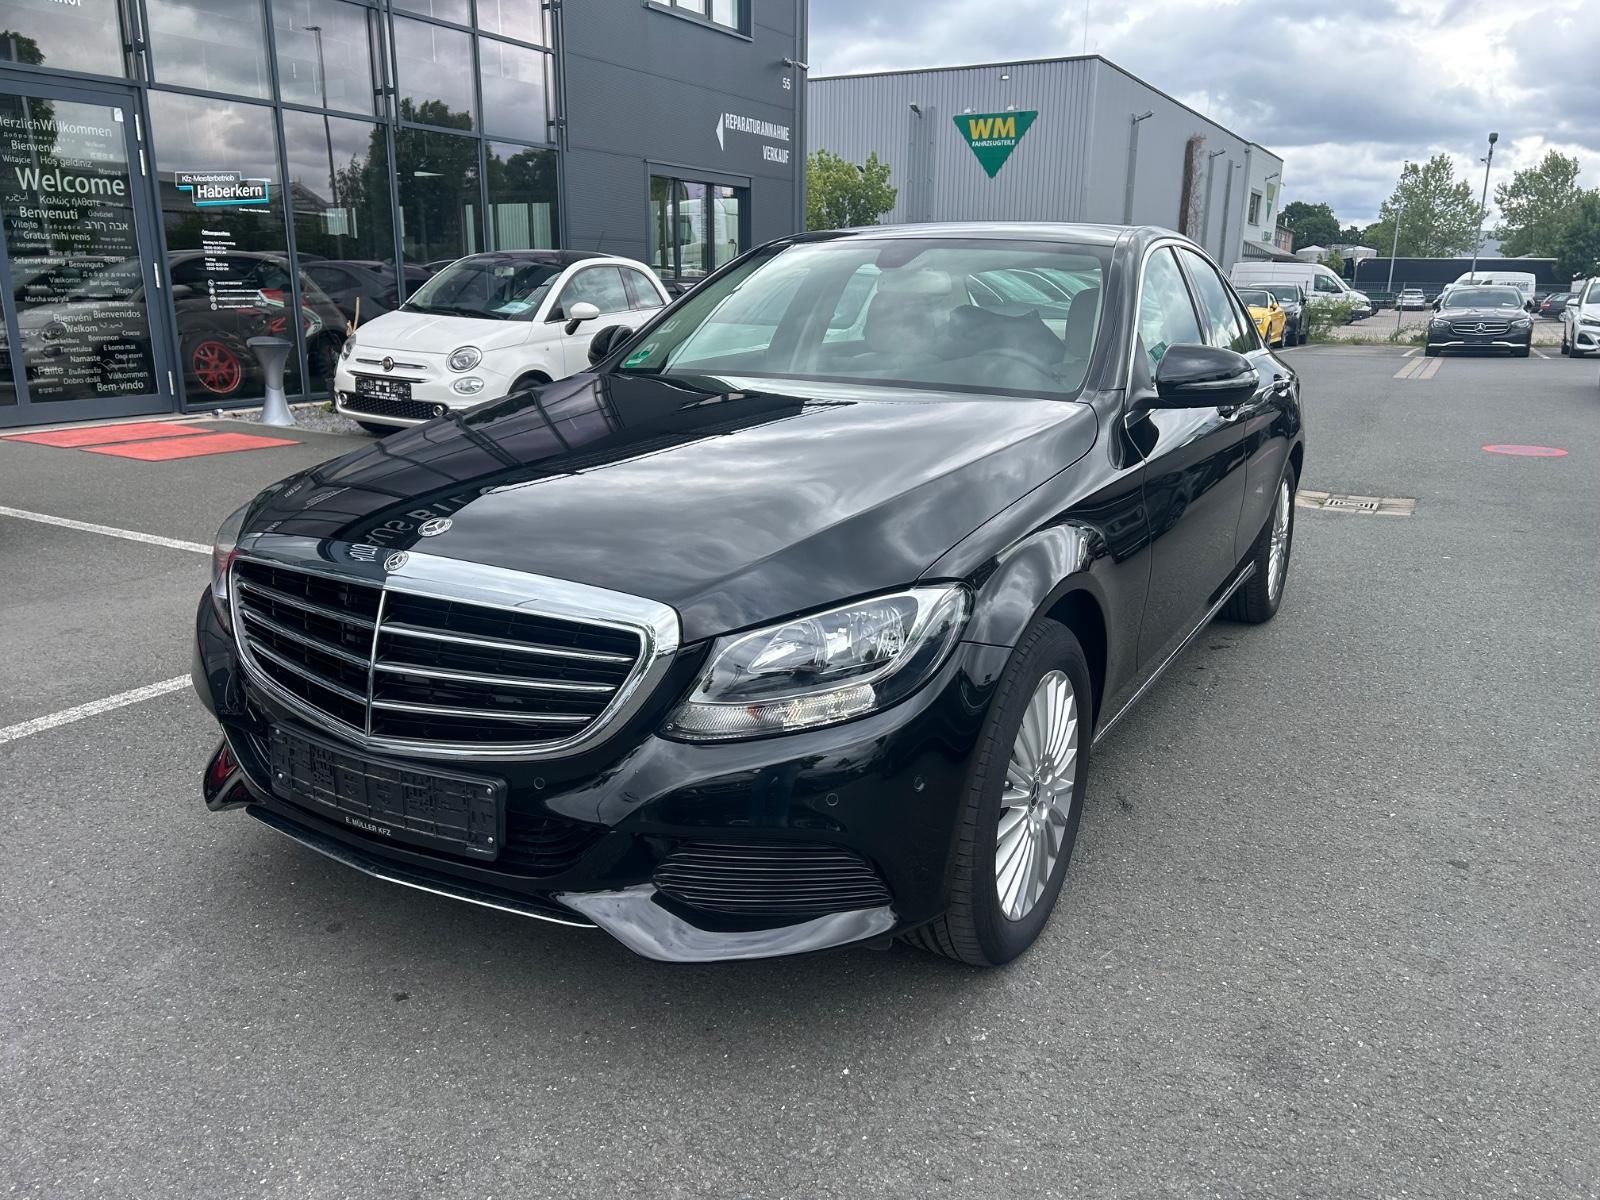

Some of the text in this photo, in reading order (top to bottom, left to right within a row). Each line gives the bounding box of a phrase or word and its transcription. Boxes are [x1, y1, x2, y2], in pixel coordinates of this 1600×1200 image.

[782, 77, 791, 90] 55
[725, 112, 790, 141] REPARATURANNAHME
[969, 116, 1016, 140] WM
[11, 139, 62, 154] Bienvenue
[971, 139, 1016, 148] FAHRZEUGTEILE
[762, 145, 790, 164] VERKAUF
[15, 166, 125, 196] Welcome
[181, 174, 235, 183] Kfz-Meisterbetrieb
[197, 184, 263, 198] Haberkern
[19, 206, 79, 220] Benvenuti
[23, 230, 50, 240] Gratus
[51, 232, 69, 241] mihi
[93, 310, 141, 319] Bienvenidos
[66, 324, 98, 333] Welkom
[97, 380, 144, 392] Bem-vindo
[378, 826, 392, 837] KFZ
